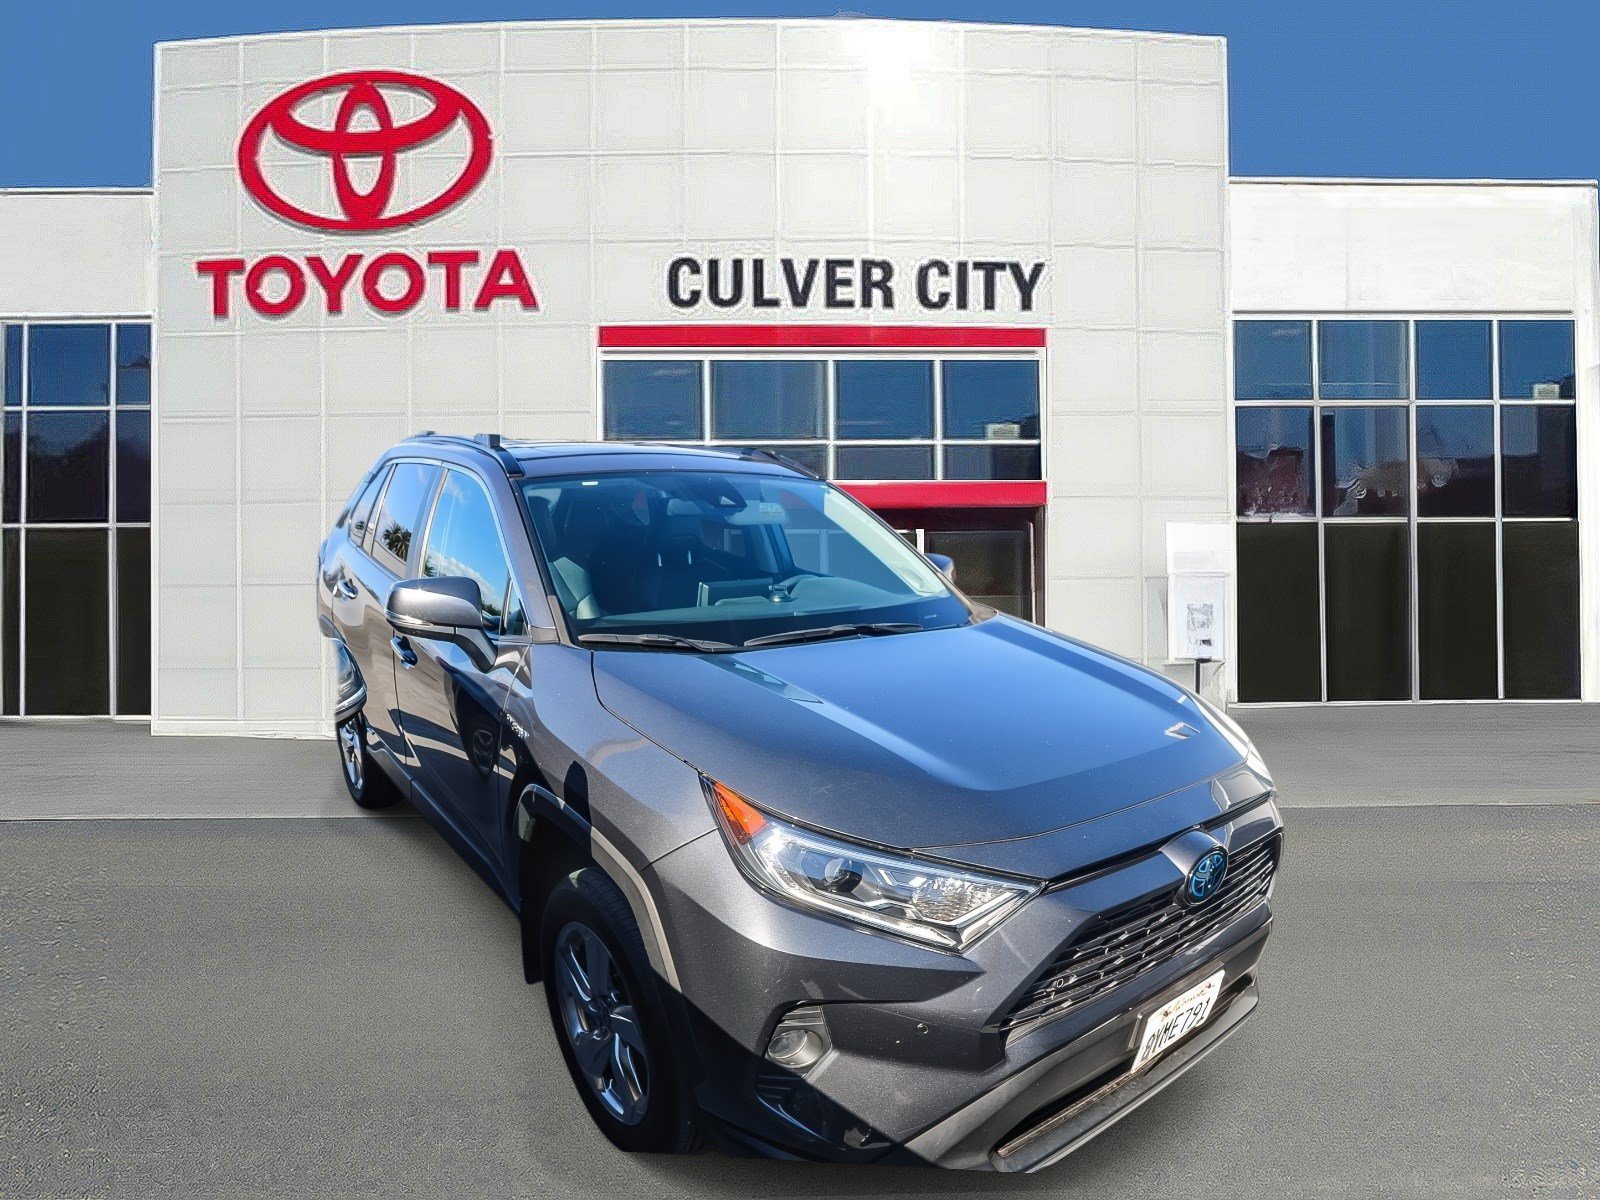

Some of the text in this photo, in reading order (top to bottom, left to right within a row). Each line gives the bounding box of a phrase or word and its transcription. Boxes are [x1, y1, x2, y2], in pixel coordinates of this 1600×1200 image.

[197, 250, 538, 317] TOYOTA
[668, 257, 1046, 311] CULVER CITY
